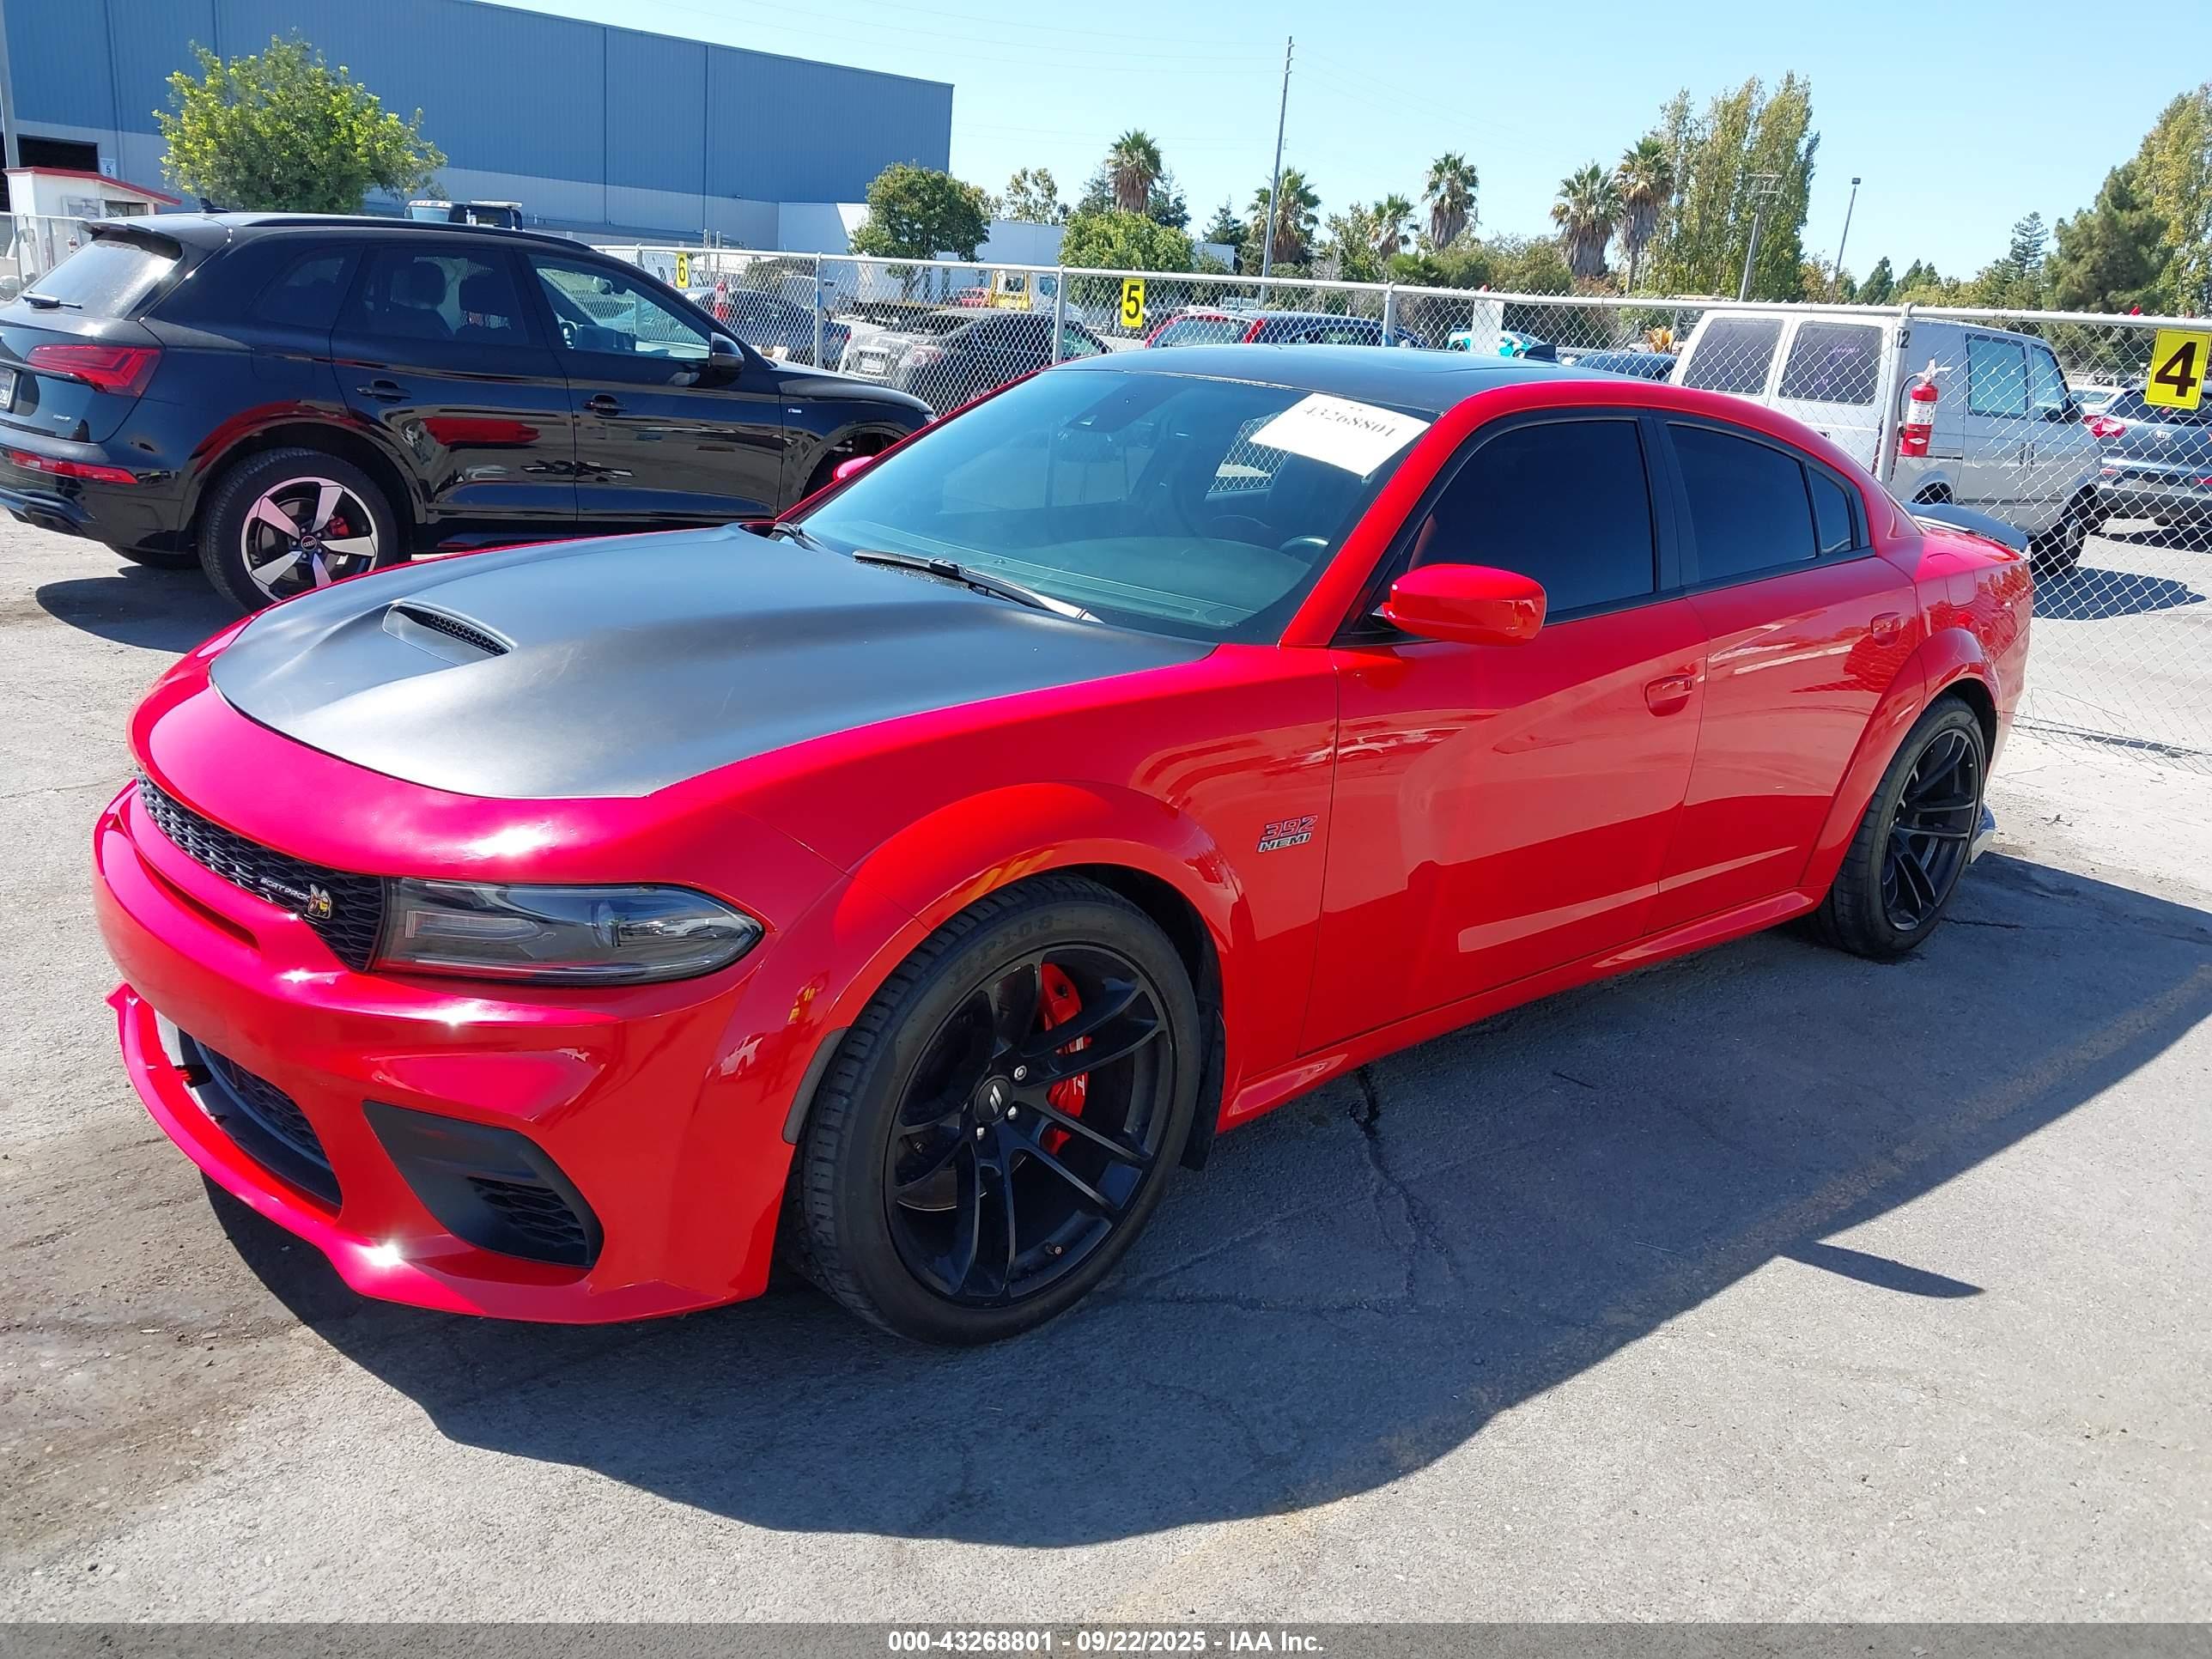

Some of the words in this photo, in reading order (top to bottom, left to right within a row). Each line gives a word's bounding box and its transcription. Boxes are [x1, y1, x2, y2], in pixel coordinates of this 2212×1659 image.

[678, 257, 686, 283] 6
[1125, 284, 1141, 319] 5
[1896, 329, 1911, 349] 12
[2154, 341, 2198, 398] 4
[1261, 814, 1318, 842] 392
[1257, 832, 1311, 853] HEMI
[260, 877, 285, 891] SCAT
[284, 887, 311, 902] PACK
